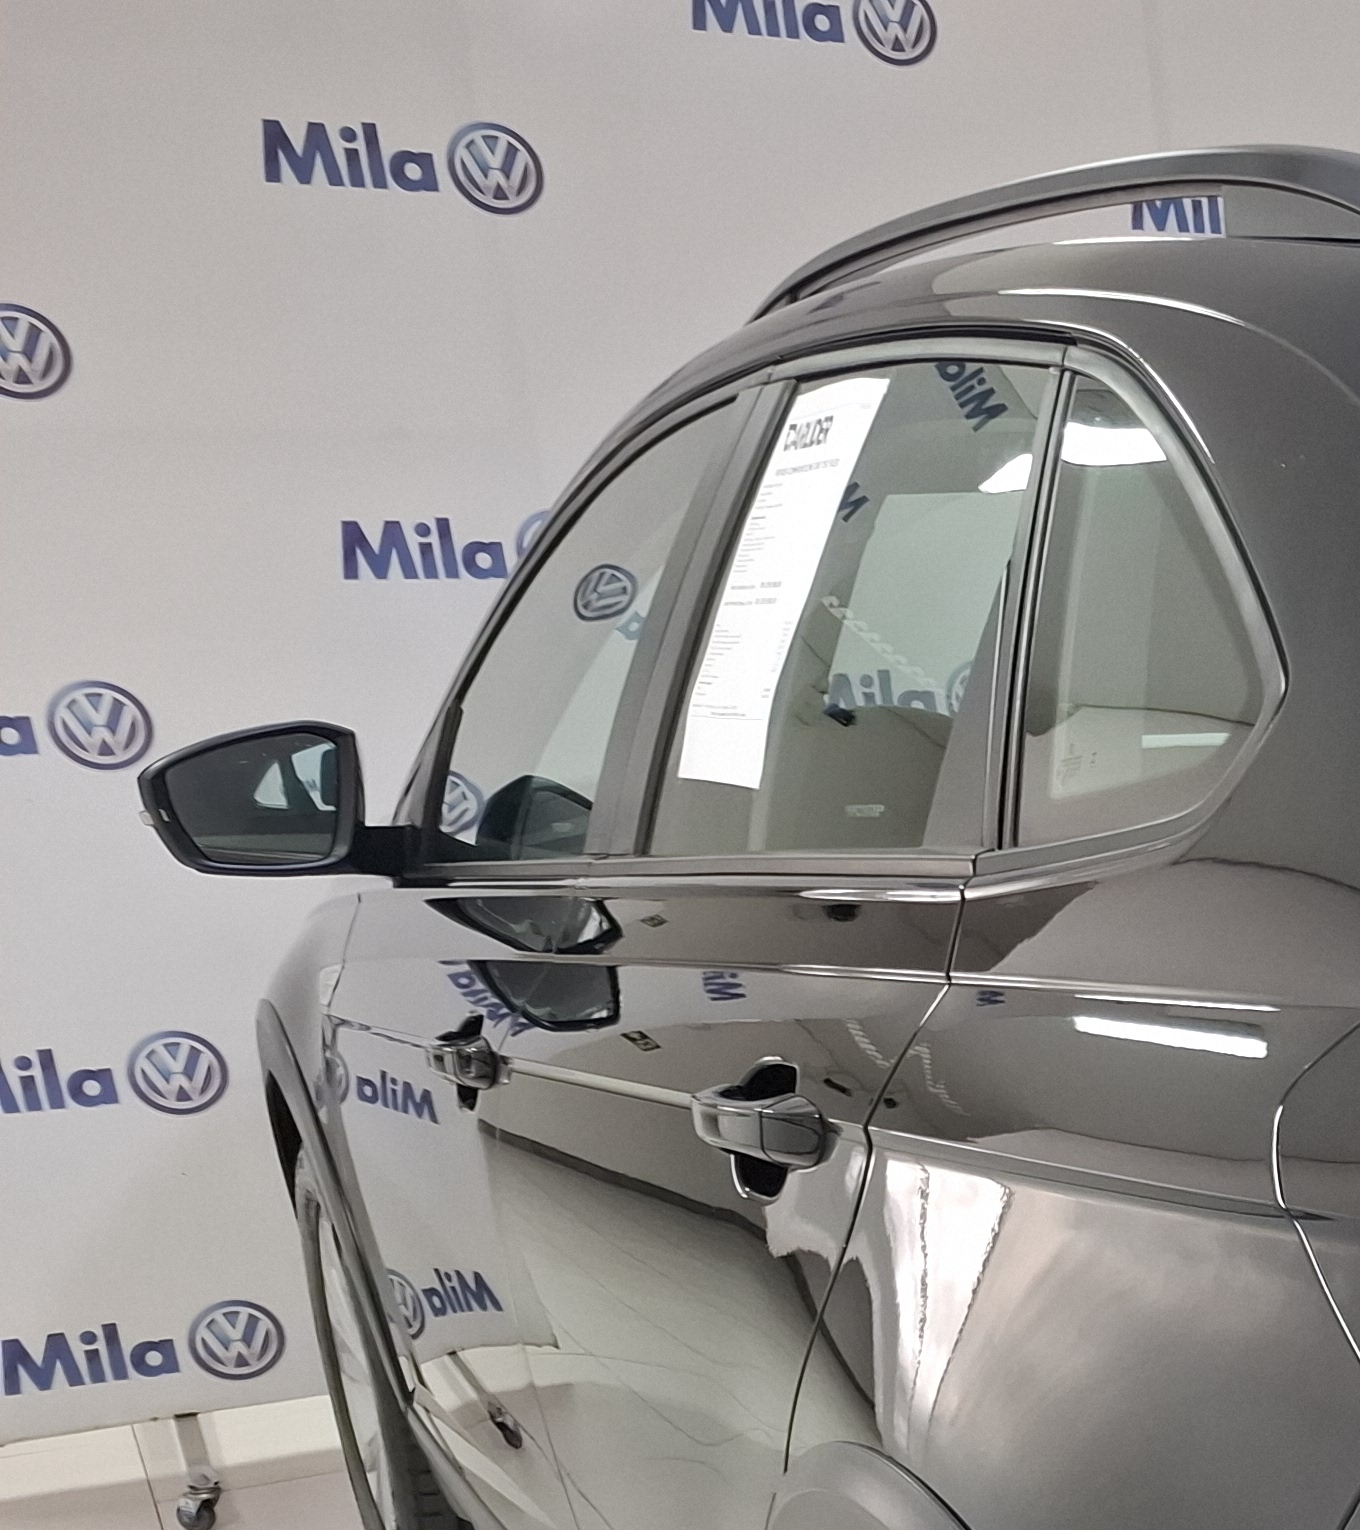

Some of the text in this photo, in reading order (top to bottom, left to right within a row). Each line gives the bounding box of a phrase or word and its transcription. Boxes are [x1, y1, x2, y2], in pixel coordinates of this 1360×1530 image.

[262, 119, 440, 192] Mila
[341, 518, 508, 581] Mila
[0, 1048, 119, 1114] ila
[1, 1322, 181, 1396] Mila
